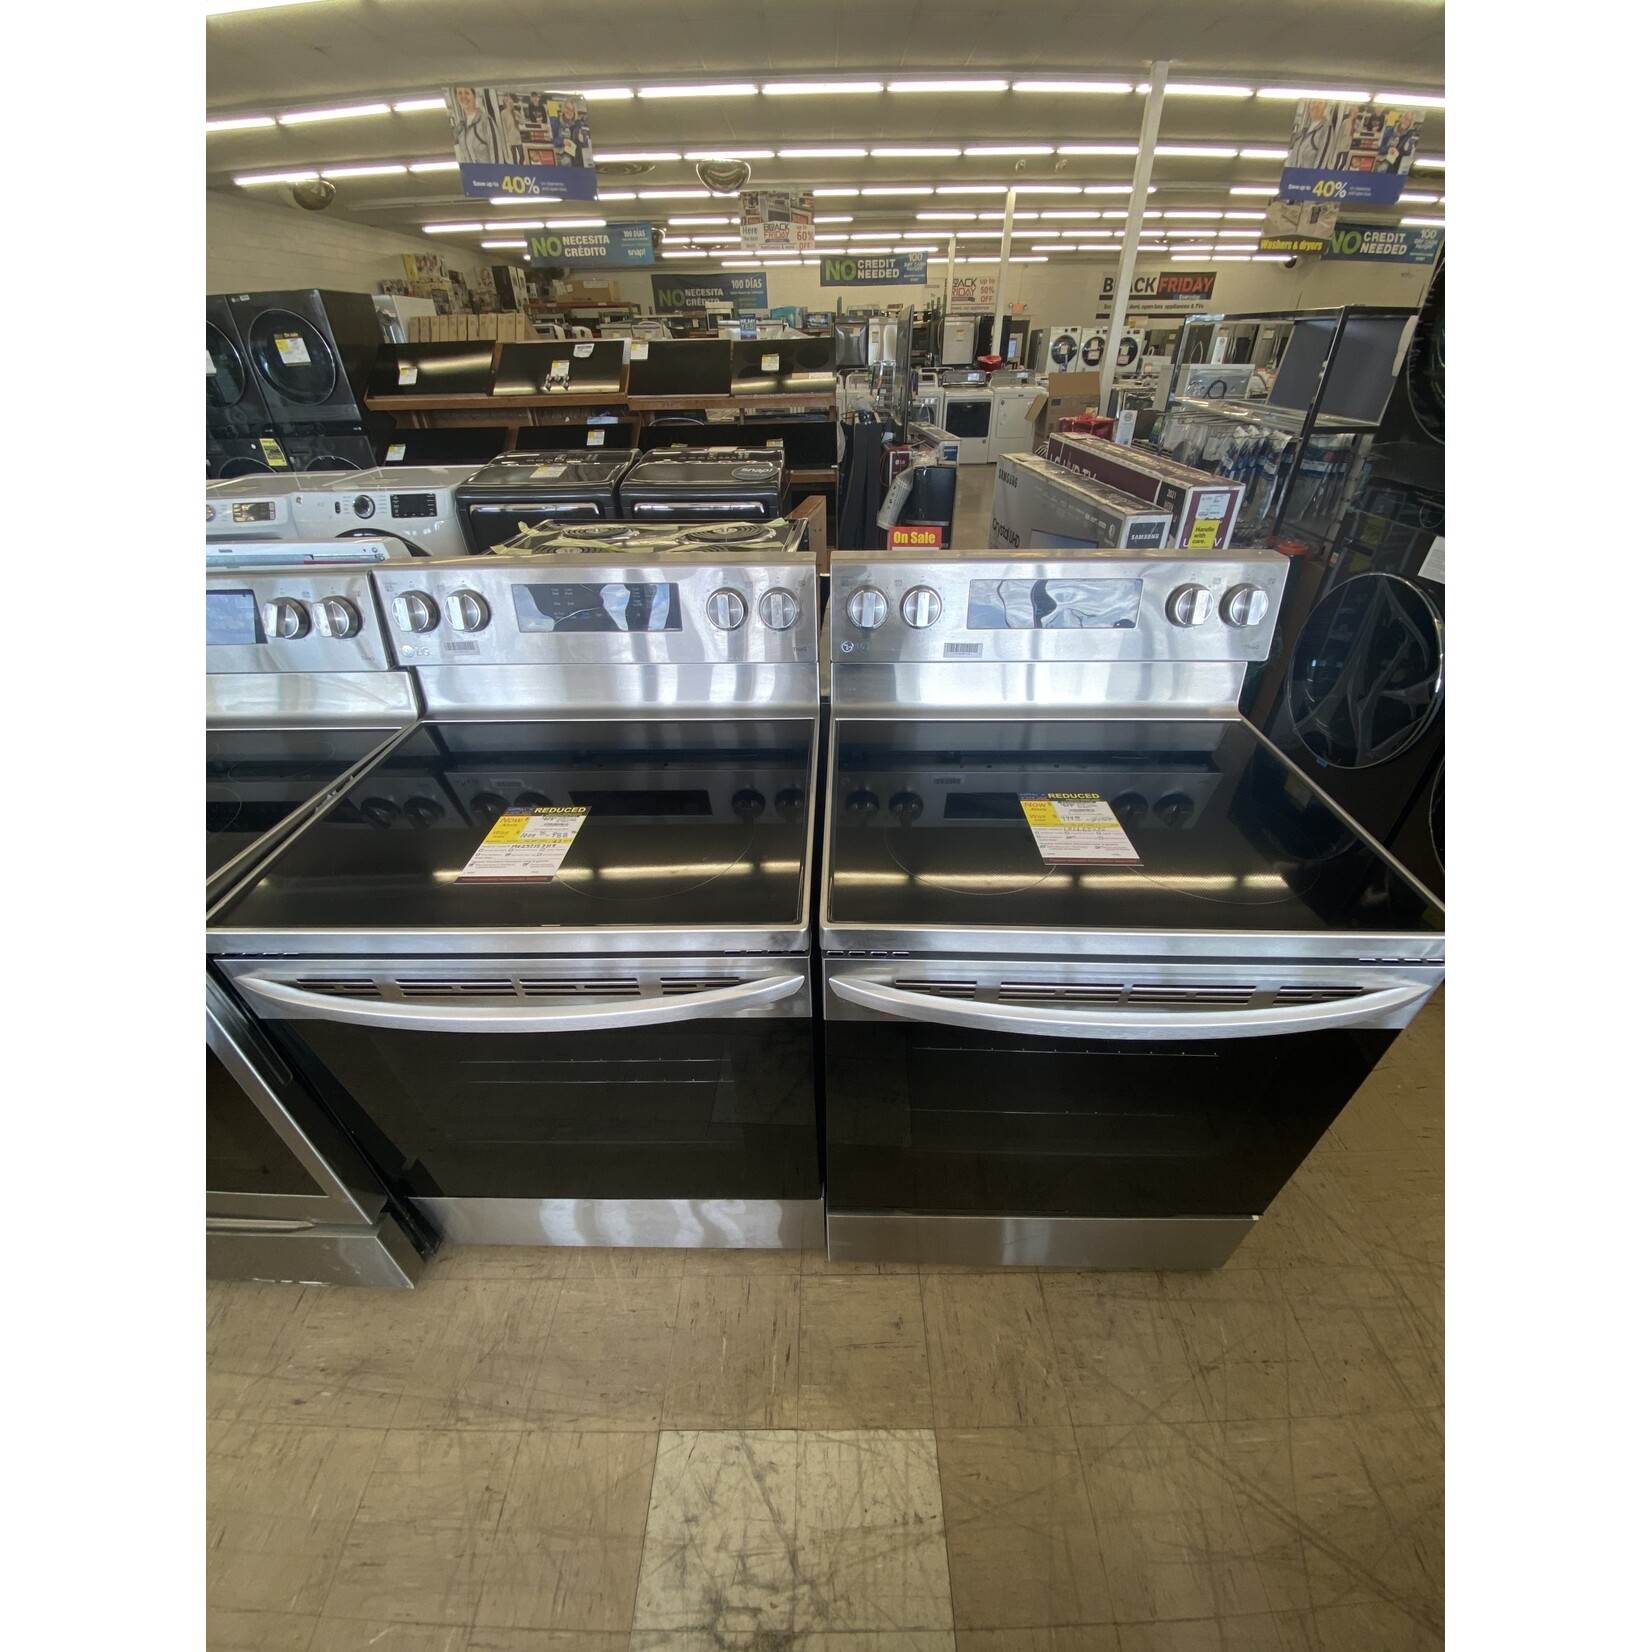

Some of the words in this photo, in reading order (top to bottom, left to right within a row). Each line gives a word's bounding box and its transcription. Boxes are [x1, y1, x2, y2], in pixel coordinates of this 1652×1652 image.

[502, 175, 540, 194] 40%
[1312, 180, 1348, 199] 40%
[623, 230, 633, 238] 100
[633, 229, 646, 238] DÍAS
[742, 227, 758, 235] Here
[764, 230, 790, 239] FRIDAY
[796, 231, 815, 241] 60%
[1420, 228, 1438, 239] 100
[562, 234, 610, 245] NECESITA
[1363, 231, 1407, 243] CREDIT
[531, 236, 562, 257] NO
[1260, 239, 1293, 250] Washers
[1293, 240, 1298, 250] &
[1300, 239, 1323, 251] dryers
[1328, 231, 1362, 255] NO
[564, 246, 607, 257] CRÉDITO
[627, 247, 646, 258] snap!
[1359, 243, 1408, 256] NEEDED
[908, 252, 923, 261] 100
[857, 258, 896, 269] CREDIT
[825, 259, 857, 281] NO
[857, 268, 900, 279] NEEDED
[730, 279, 743, 289] 100
[745, 277, 762, 289] DÍAS
[1102, 277, 1157, 293] BCK
[1158, 277, 1214, 293] FRIDAY
[685, 288, 723, 296] NECESITA
[980, 286, 994, 294] 50%
[657, 289, 686, 307] NO
[998, 468, 1018, 488] SAMSUNG
[893, 531, 909, 544] On
[910, 531, 936, 544] Sale
[1131, 533, 1160, 541] SAMSUNG
